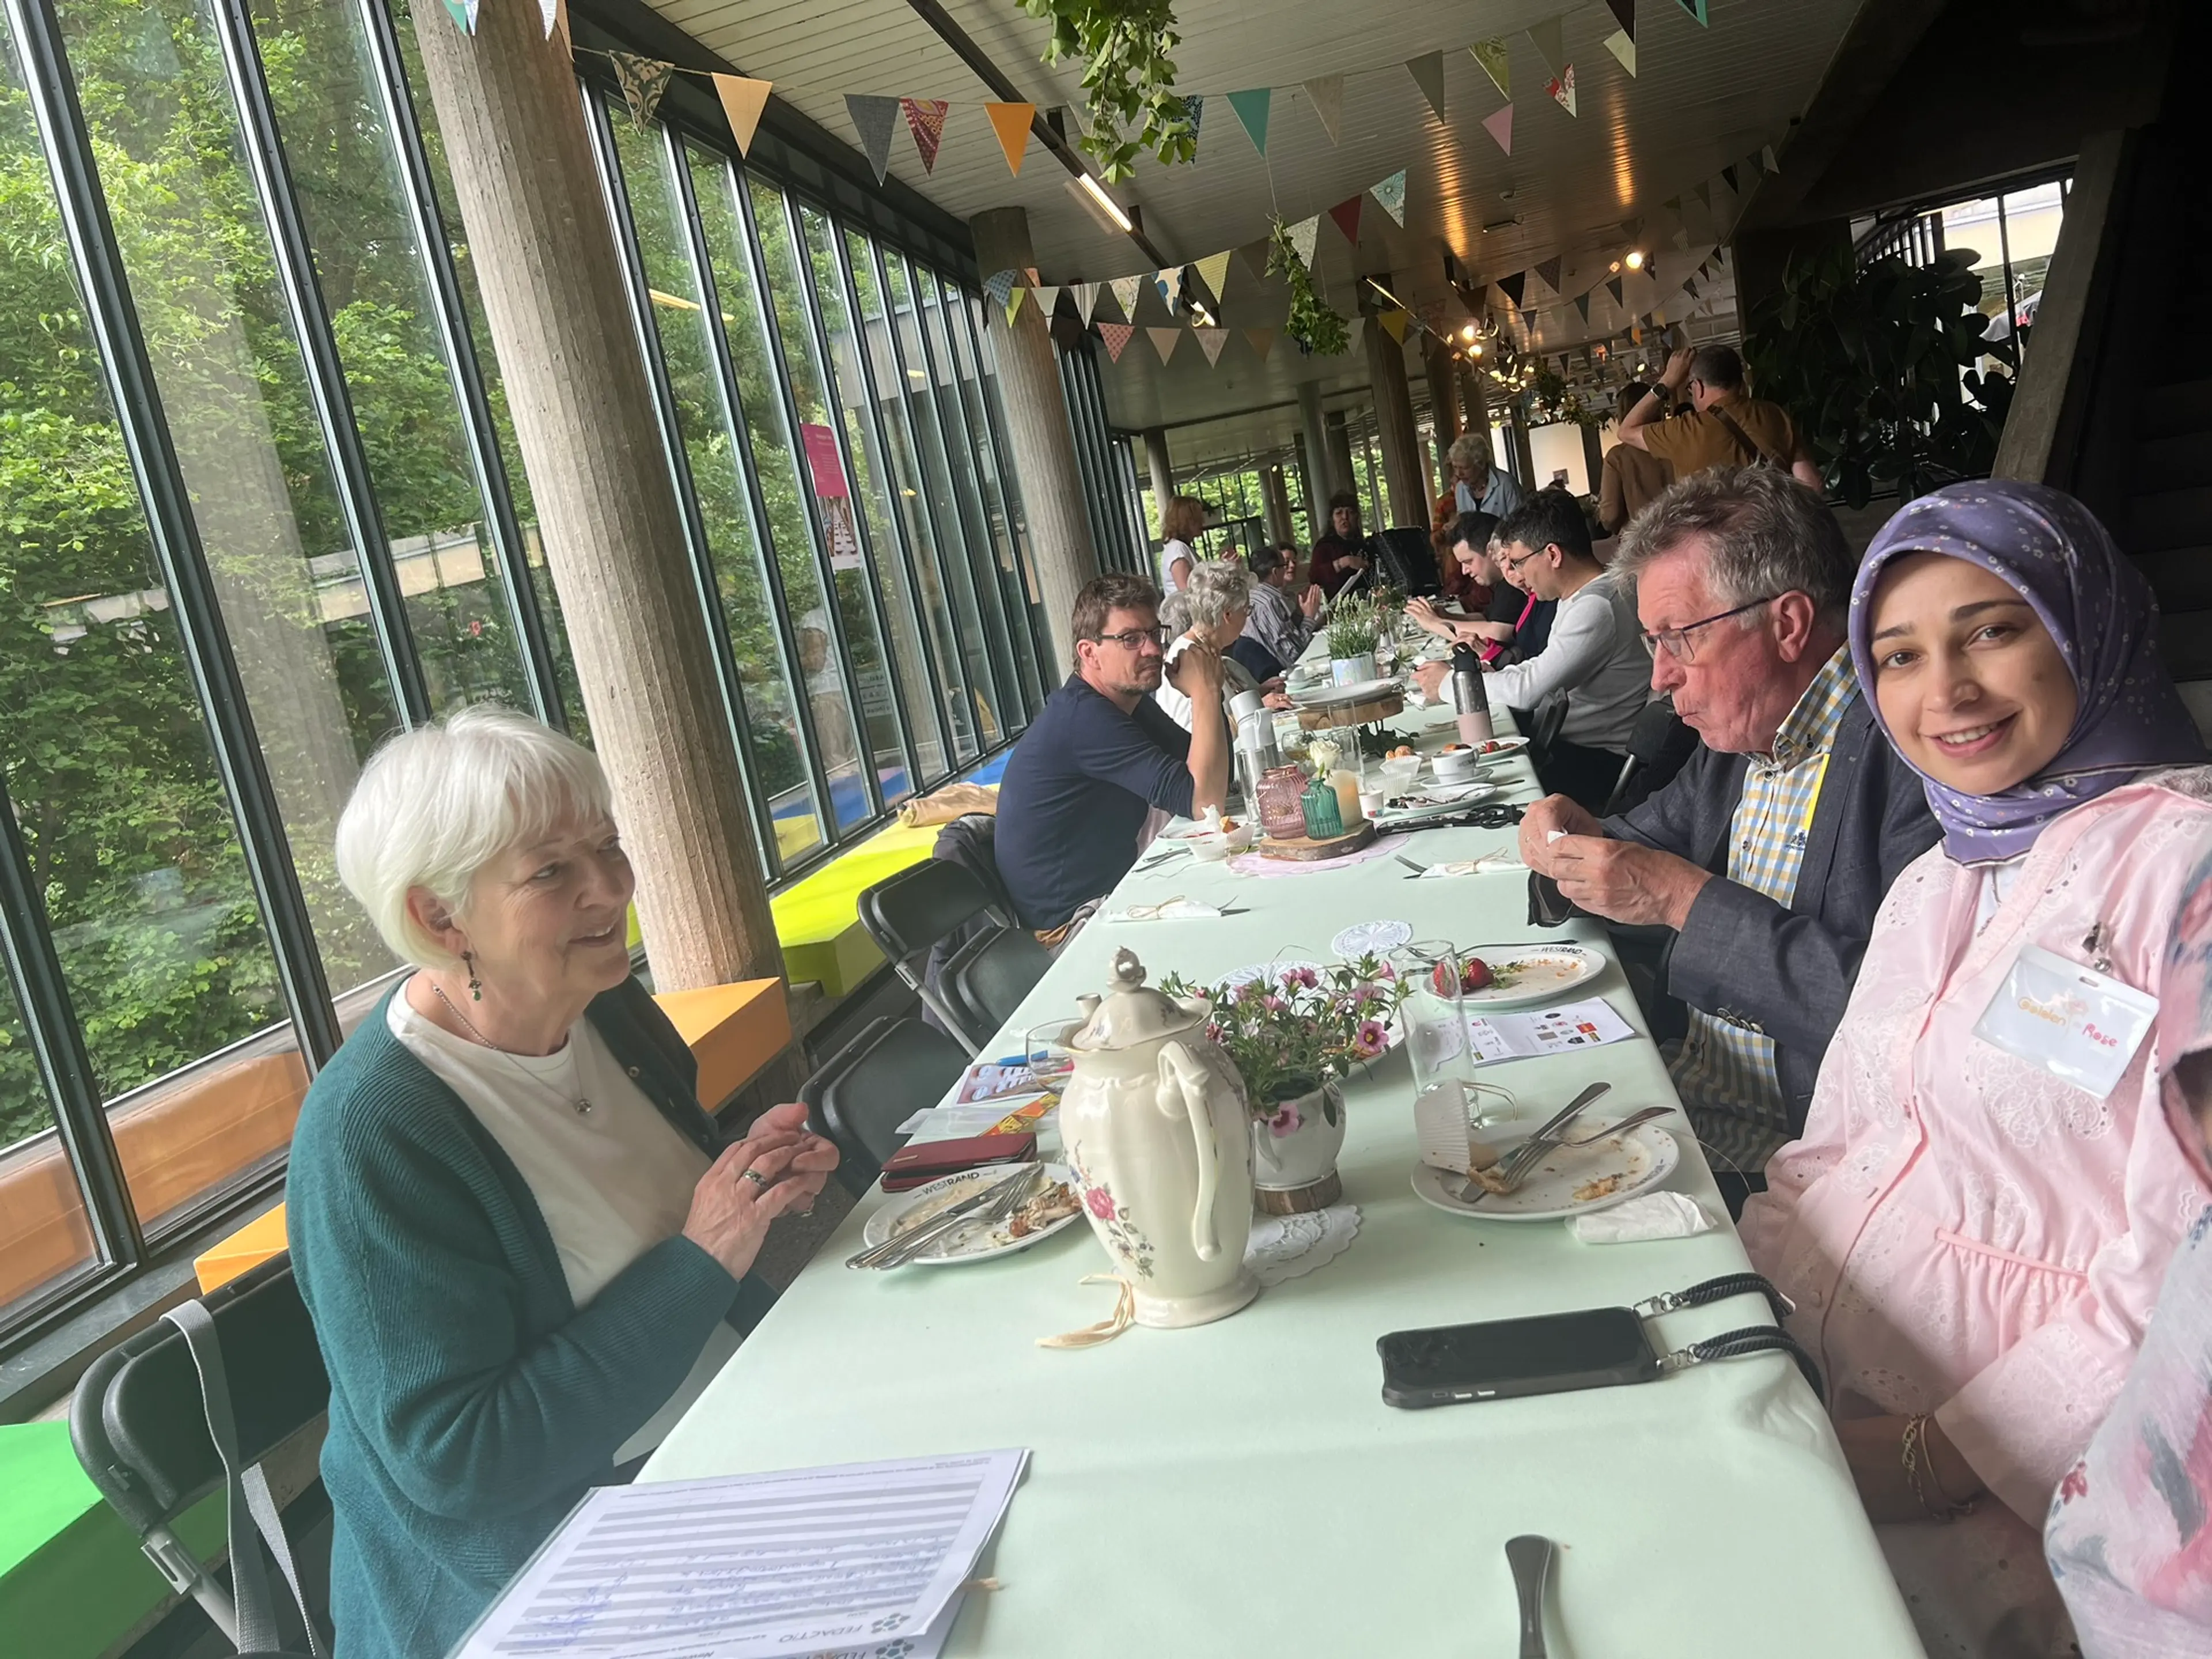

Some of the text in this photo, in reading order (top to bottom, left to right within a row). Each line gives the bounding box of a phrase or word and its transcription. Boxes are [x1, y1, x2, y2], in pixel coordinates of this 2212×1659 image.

[2082, 1023, 2118, 1047] Rose
[922, 1172, 980, 1194] WESTRAND
[779, 1624, 863, 1643] FEDACTIO
